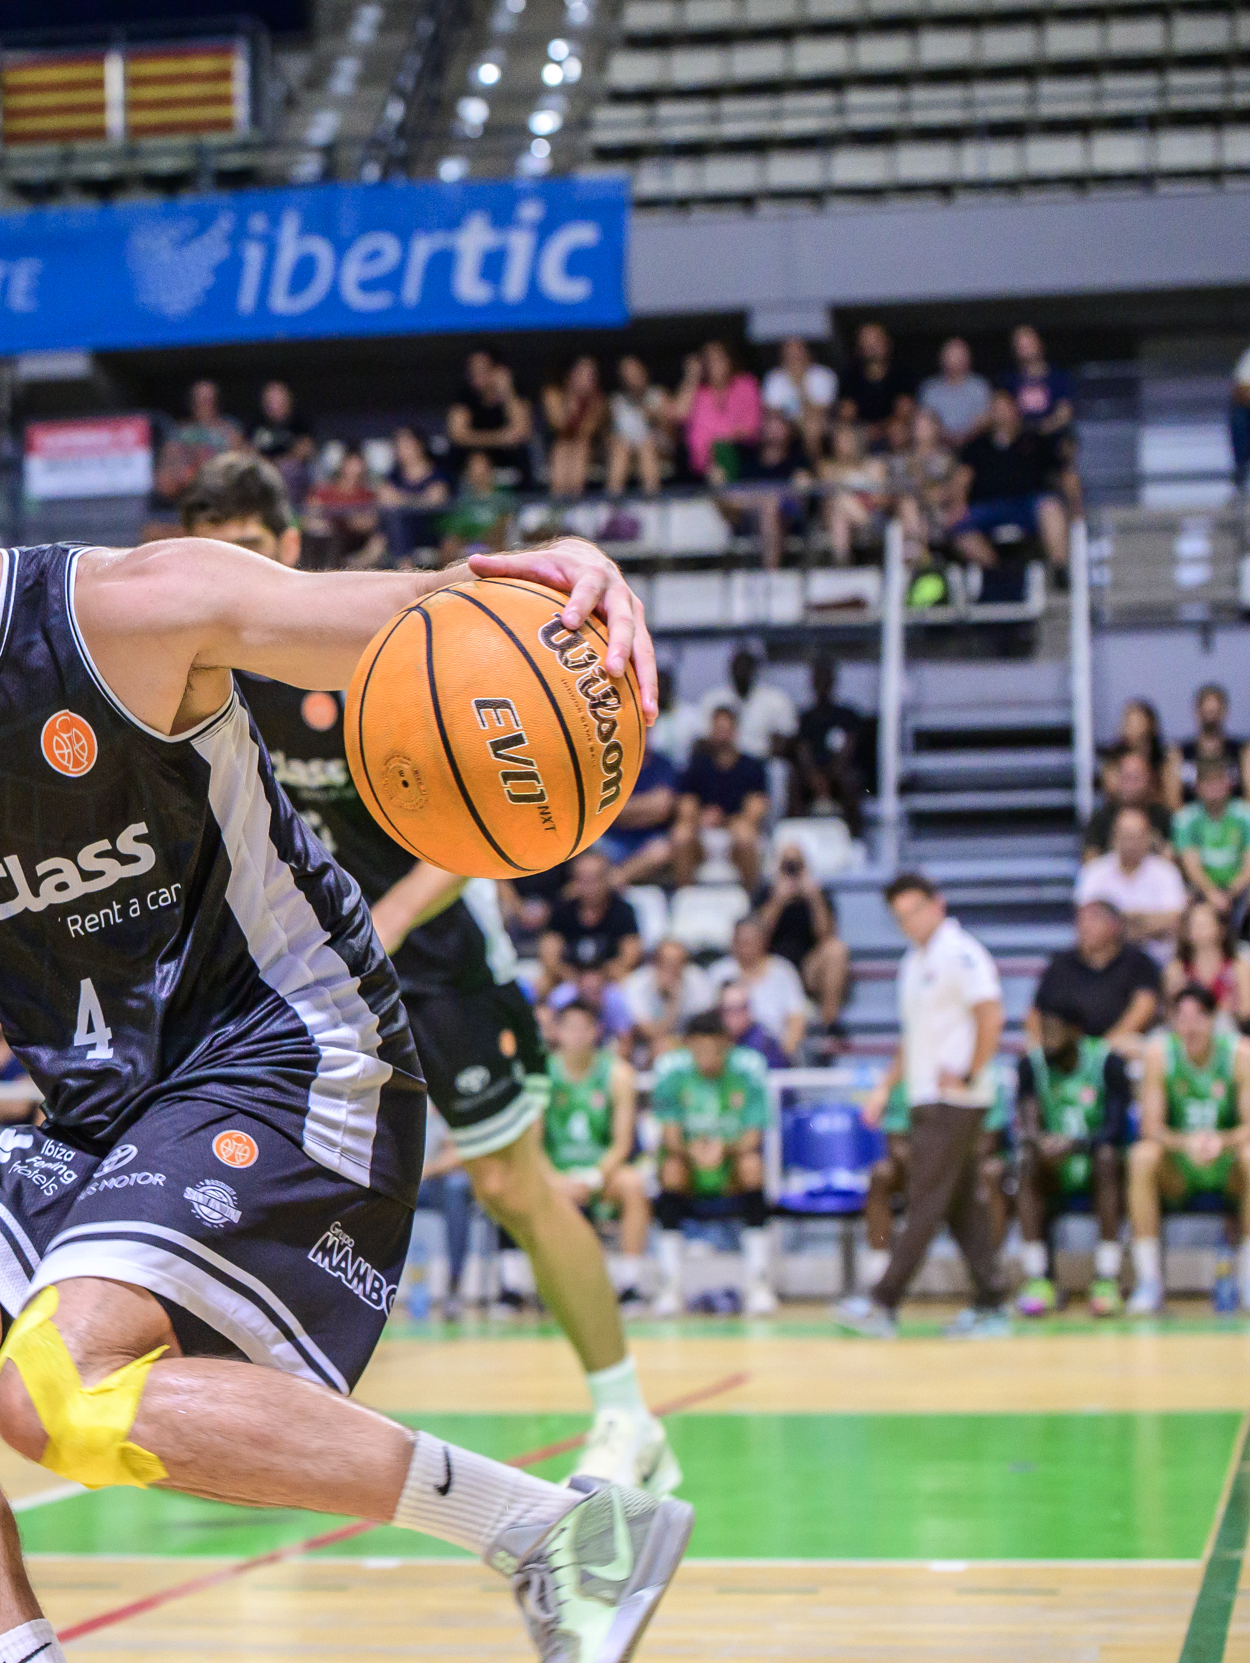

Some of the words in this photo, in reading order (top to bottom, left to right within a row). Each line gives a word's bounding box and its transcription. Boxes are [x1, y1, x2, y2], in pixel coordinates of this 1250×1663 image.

[237, 200, 602, 316] ibertic
[470, 697, 550, 805] EVO
[536, 804, 558, 832] NXT
[66, 901, 123, 938] Rent
[129, 898, 141, 918] a
[147, 883, 182, 910] car
[73, 977, 114, 1060] 4
[41, 1139, 76, 1162] Ibiza
[8, 1160, 59, 1197] Hotels
[330, 1221, 355, 1248] Grupo
